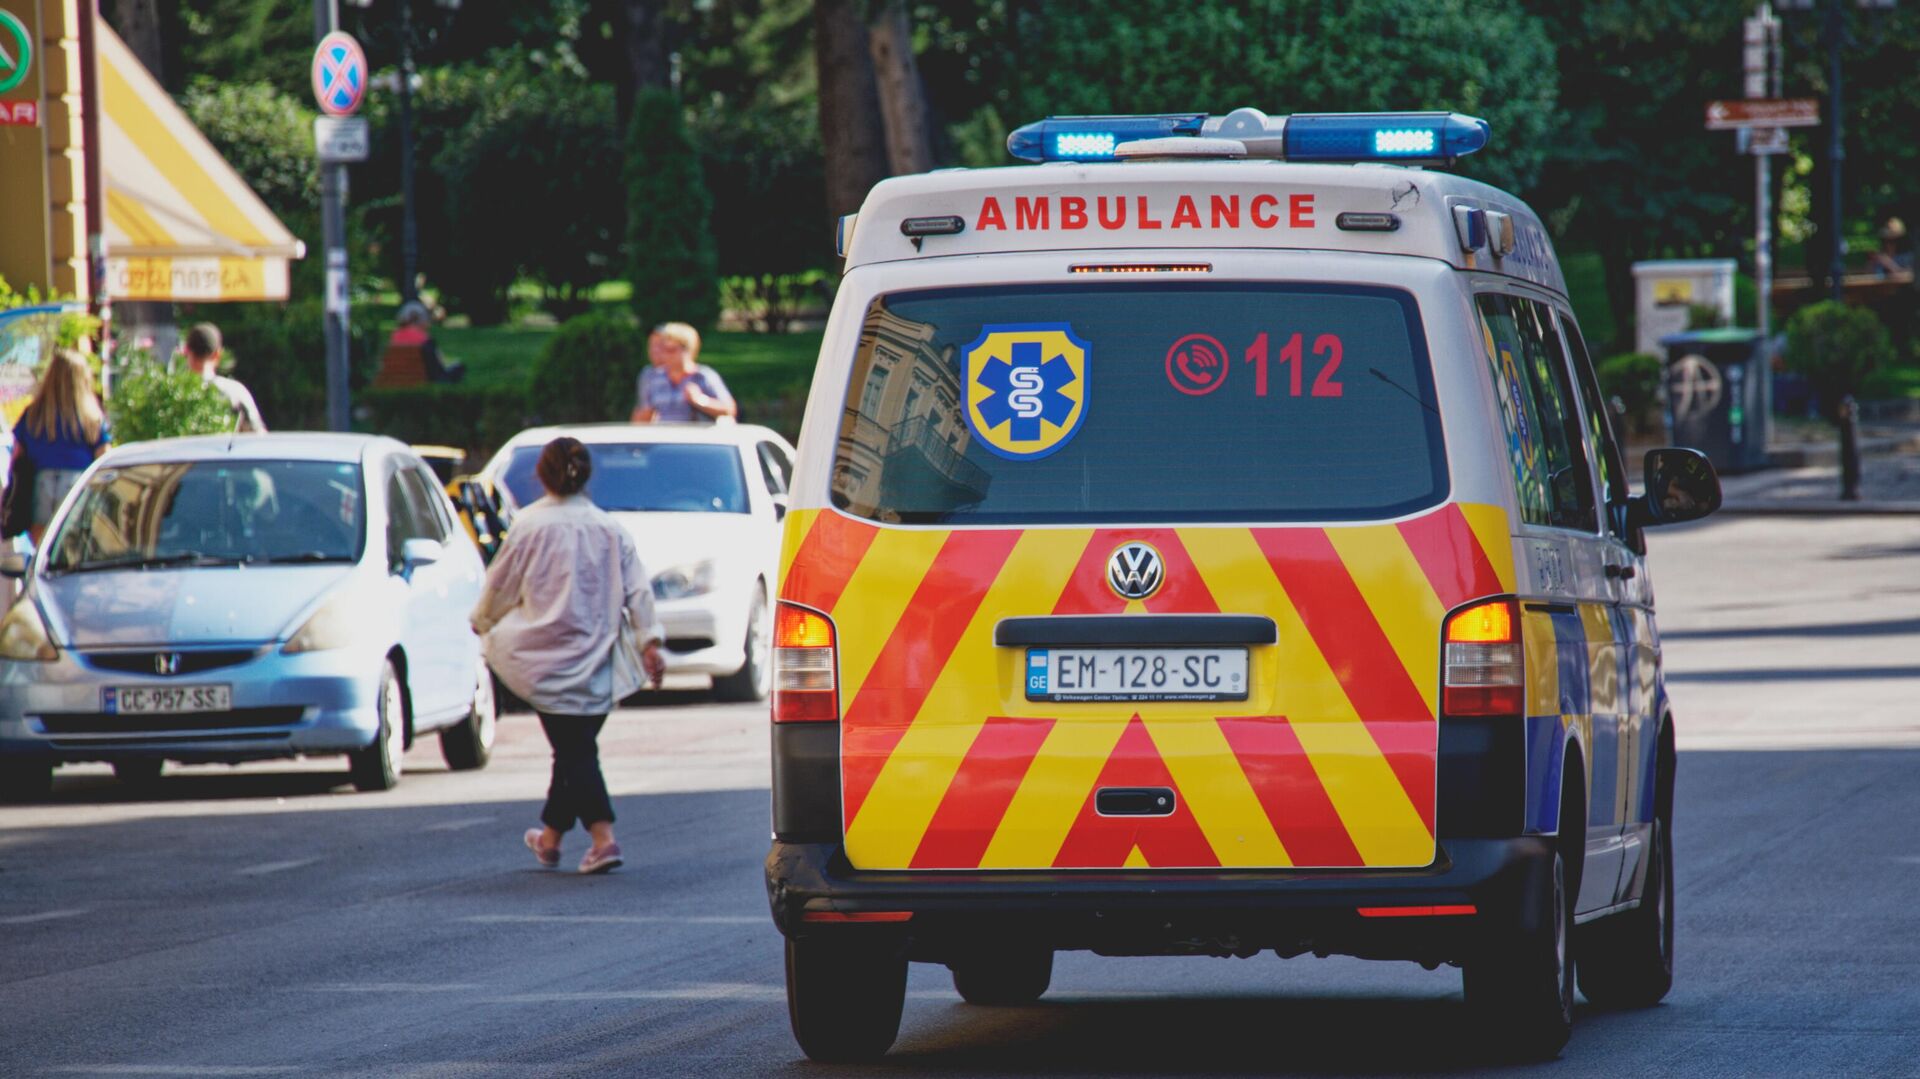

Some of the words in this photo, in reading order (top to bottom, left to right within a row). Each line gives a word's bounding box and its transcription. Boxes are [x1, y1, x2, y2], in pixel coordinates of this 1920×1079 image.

[975, 194, 1316, 231] AMBULANCE
[1245, 331, 1344, 398] 112
[1030, 675, 1047, 689] GE
[1057, 655, 1221, 688] EM-128-SC
[121, 688, 216, 711] CC-957-SS
